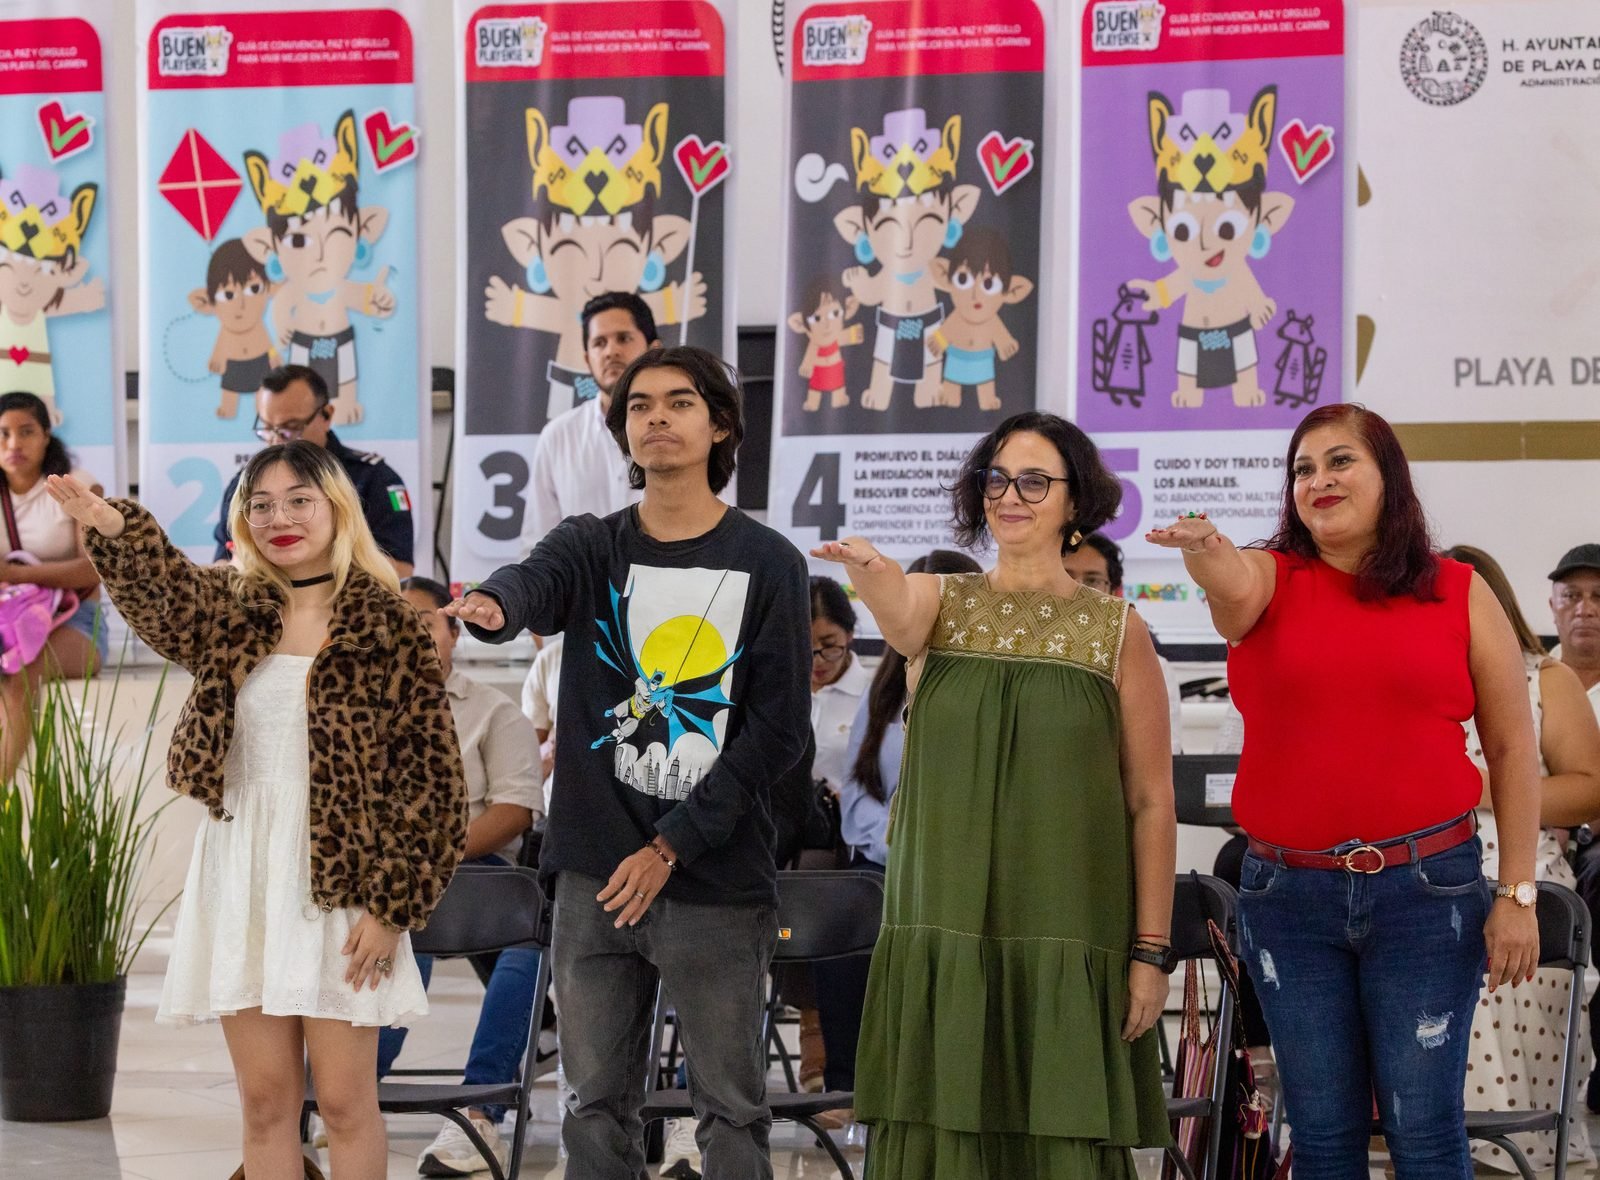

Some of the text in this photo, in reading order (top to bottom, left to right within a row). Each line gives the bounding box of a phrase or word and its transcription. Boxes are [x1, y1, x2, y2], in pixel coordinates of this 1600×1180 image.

[1096, 9, 1138, 32] BUEN
[479, 26, 521, 48] BUEN
[807, 25, 847, 47] BUEN
[1503, 36, 1600, 52] H. AYUNTA
[162, 35, 205, 56] BUEN
[1503, 60, 1524, 73] DE
[1532, 59, 1586, 72] PLAYA
[1454, 357, 1554, 387] PLAYA
[855, 450, 918, 462] PROMUEVO
[922, 450, 932, 461] EL
[1154, 458, 1191, 470] CUIDO
[1194, 458, 1202, 469] Y
[1204, 458, 1229, 469] DOY
[1232, 457, 1269, 468] TRATO
[854, 470, 867, 480] LA
[871, 468, 932, 480] MEDIACIÓN
[1154, 477, 1239, 488] LOS ANIMALES.
[477, 451, 529, 540] 3
[791, 452, 846, 541] 4
[854, 488, 908, 498] RESOLVER
[1098, 448, 1142, 541] 5
[1154, 493, 1168, 502] NO
[1228, 492, 1244, 502] NO
[168, 456, 222, 547] 2
[852, 504, 864, 514] LA
[866, 504, 882, 514] PAZ
[884, 504, 930, 514] COMIENZA
[852, 520, 913, 530] COMPRENDER
[916, 520, 921, 529] Y
